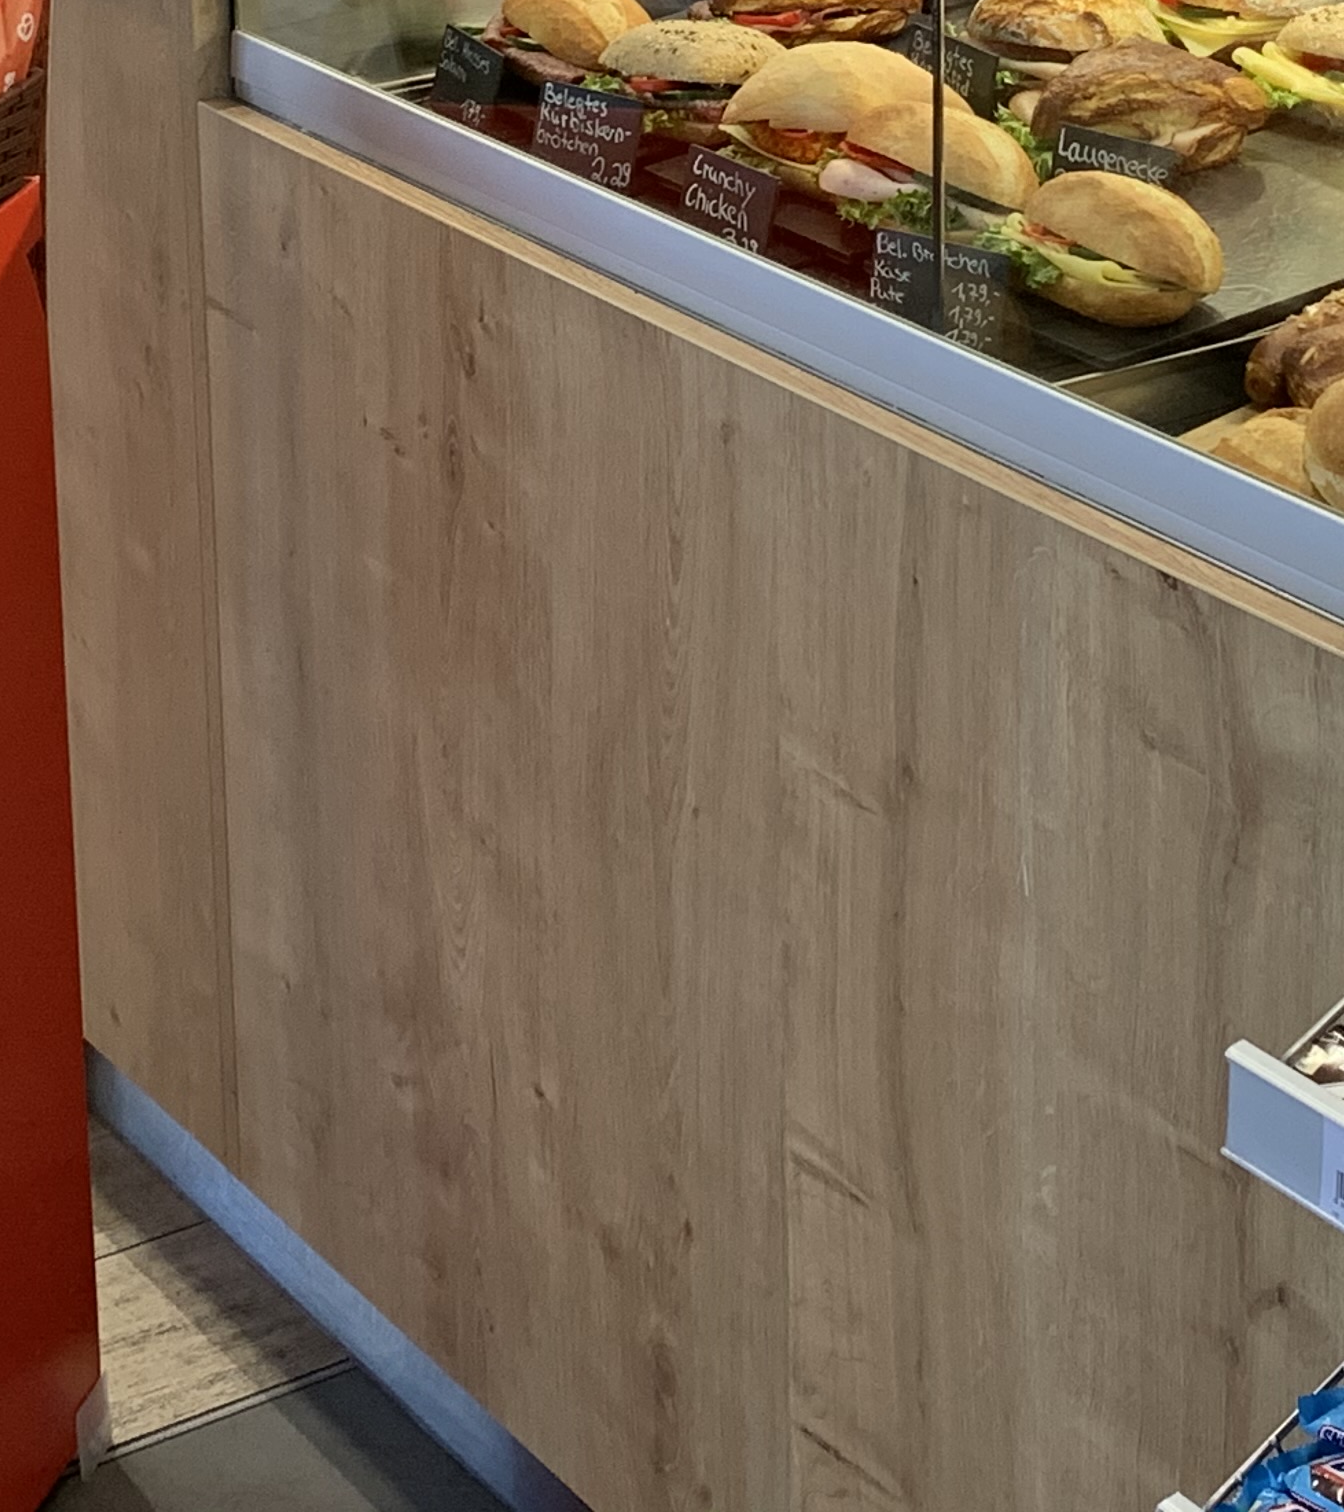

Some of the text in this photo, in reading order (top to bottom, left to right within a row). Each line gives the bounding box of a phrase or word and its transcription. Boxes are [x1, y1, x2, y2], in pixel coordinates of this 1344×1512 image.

[912, 29, 975, 78] Begtes
[543, 81, 609, 119] Belegtes
[539, 102, 633, 144] Kürbiskern-
[590, 156, 632, 189] 2,29
[1057, 127, 1169, 185] Laugenecke
[692, 153, 757, 209] Crunchy
[684, 183, 748, 232] Chicken
[722, 227, 759, 254] 319
[876, 231, 908, 259] Bel.
